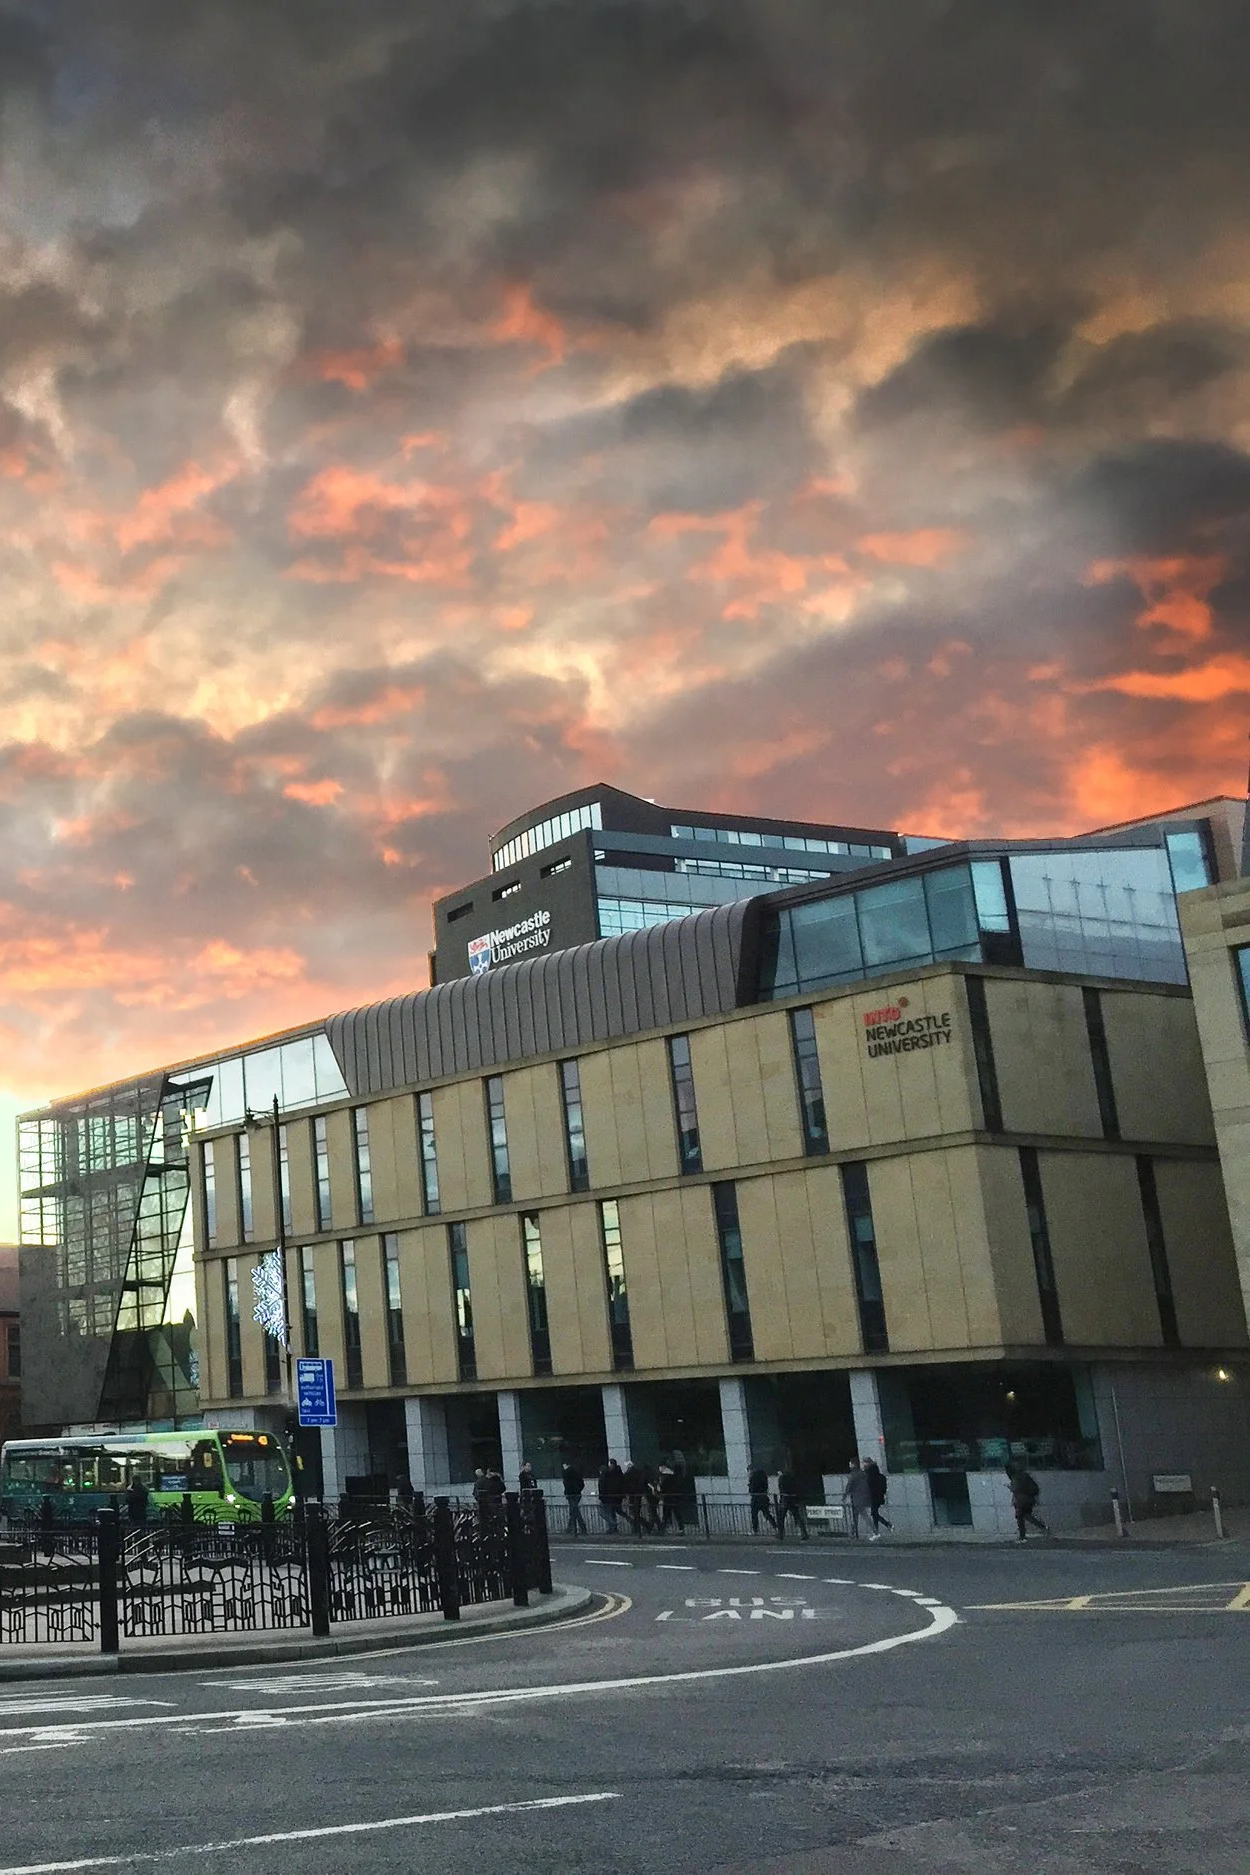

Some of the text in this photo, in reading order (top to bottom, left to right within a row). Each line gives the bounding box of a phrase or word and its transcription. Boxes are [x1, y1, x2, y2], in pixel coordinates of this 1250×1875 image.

[490, 910, 551, 947] Newcastle
[490, 928, 551, 963] University
[865, 1012, 952, 1042] NEWCASTLE
[867, 1029, 952, 1058] UNIVERSITY
[654, 1608, 842, 1621] LANE
[685, 1597, 806, 1607] BUS
